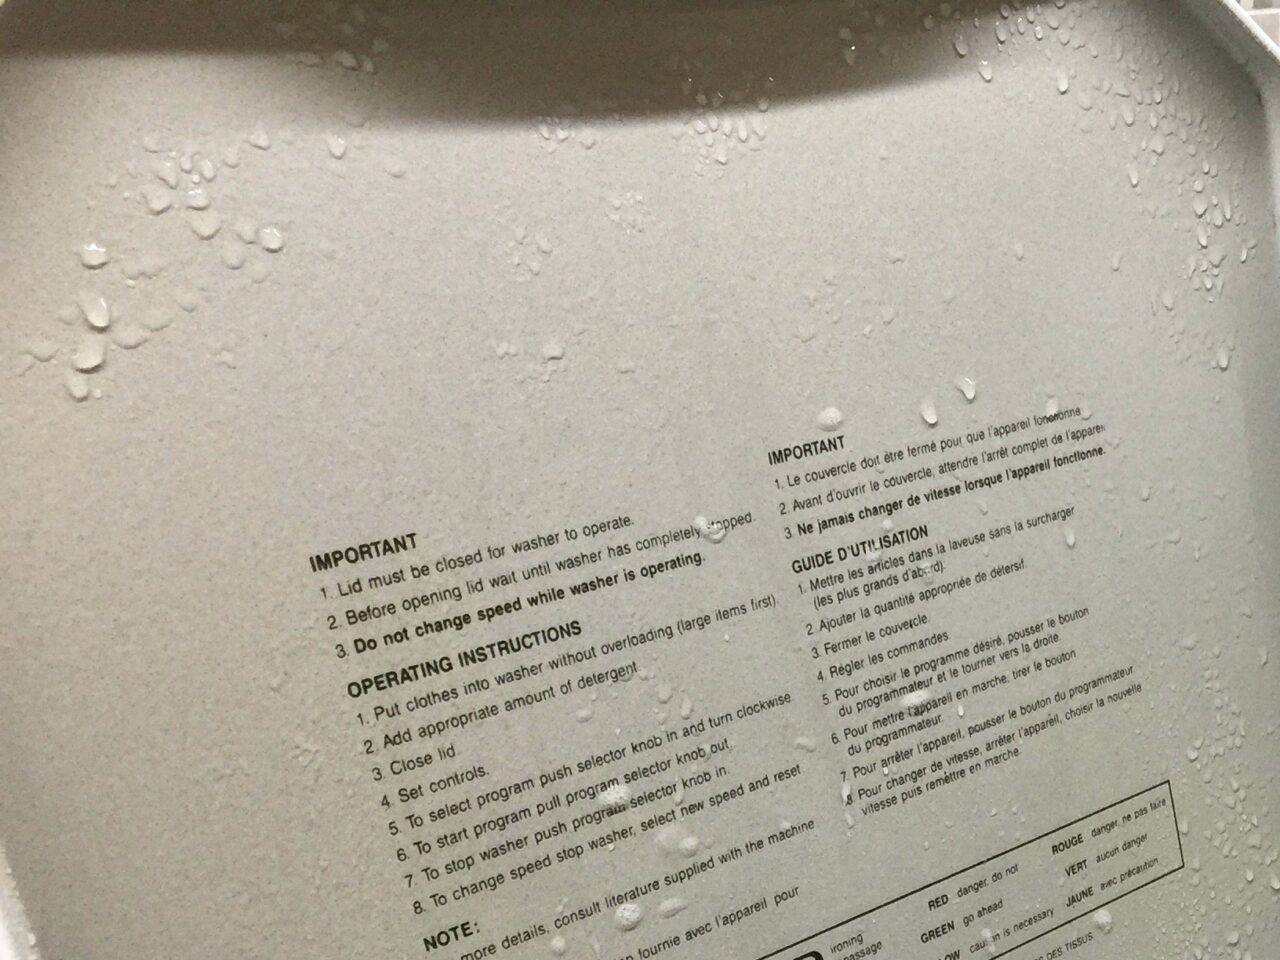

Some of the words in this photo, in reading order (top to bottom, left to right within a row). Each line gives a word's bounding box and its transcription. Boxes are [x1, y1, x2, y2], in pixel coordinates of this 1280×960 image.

[767, 434, 844, 466] IMPORTANT
[796, 522, 814, 536] Ne
[816, 511, 855, 534] jamais
[858, 499, 903, 520] changer
[906, 493, 920, 507] de
[923, 479, 962, 502] vitesse
[963, 473, 1003, 492] lorsque
[1005, 458, 1050, 480] l'appareil
[308, 532, 417, 573] IMPORTANT
[336, 577, 363, 597] Lid
[367, 568, 406, 589] must
[409, 564, 430, 578] be
[435, 548, 483, 573] closed
[486, 545, 505, 559] for
[511, 532, 559, 553] washer
[564, 528, 578, 541] to
[791, 549, 834, 574] GUIDE
[837, 524, 928, 561] D'UTILISATION
[353, 637, 377, 654] Do
[382, 626, 410, 646] not
[414, 613, 472, 637] change
[476, 596, 522, 623] speed
[526, 587, 565, 607] while
[568, 573, 618, 596] washer
[622, 568, 636, 582] is
[347, 655, 453, 698] OPERATING
[457, 619, 582, 667] INSTRUCTIONS
[373, 702, 401, 721] Put
[405, 687, 459, 712] clothes
[463, 678, 490, 695] into
[494, 662, 543, 685] washer
[548, 645, 597, 670] without
[600, 625, 674, 655] overloading
[676, 614, 711, 635] (large
[714, 603, 747, 621] items
[750, 593, 776, 611] first)
[829, 658, 864, 678] Régler
[867, 652, 884, 665] les
[404, 813, 423, 829] To
[428, 797, 472, 822] select
[476, 778, 535, 810] program
[538, 764, 572, 788] push
[576, 747, 626, 772] selector
[630, 734, 662, 754] knob
[665, 730, 678, 742] in
[682, 718, 705, 737] and
[708, 712, 733, 728] turn
[736, 693, 791, 719] clockwise
[397, 784, 424, 803] Set
[428, 892, 447, 907] To
[452, 873, 505, 900] change
[509, 853, 551, 880] speed
[555, 844, 584, 862] stop
[587, 826, 636, 850] washer,
[640, 808, 676, 831] select
[680, 800, 704, 817] new
[708, 783, 744, 807] speed
[748, 774, 770, 792] and
[773, 763, 801, 782] reset
[422, 920, 480, 952] NOTE:
[920, 919, 955, 943] GREEN
[962, 913, 974, 927] go
[976, 898, 1003, 918] ahead
